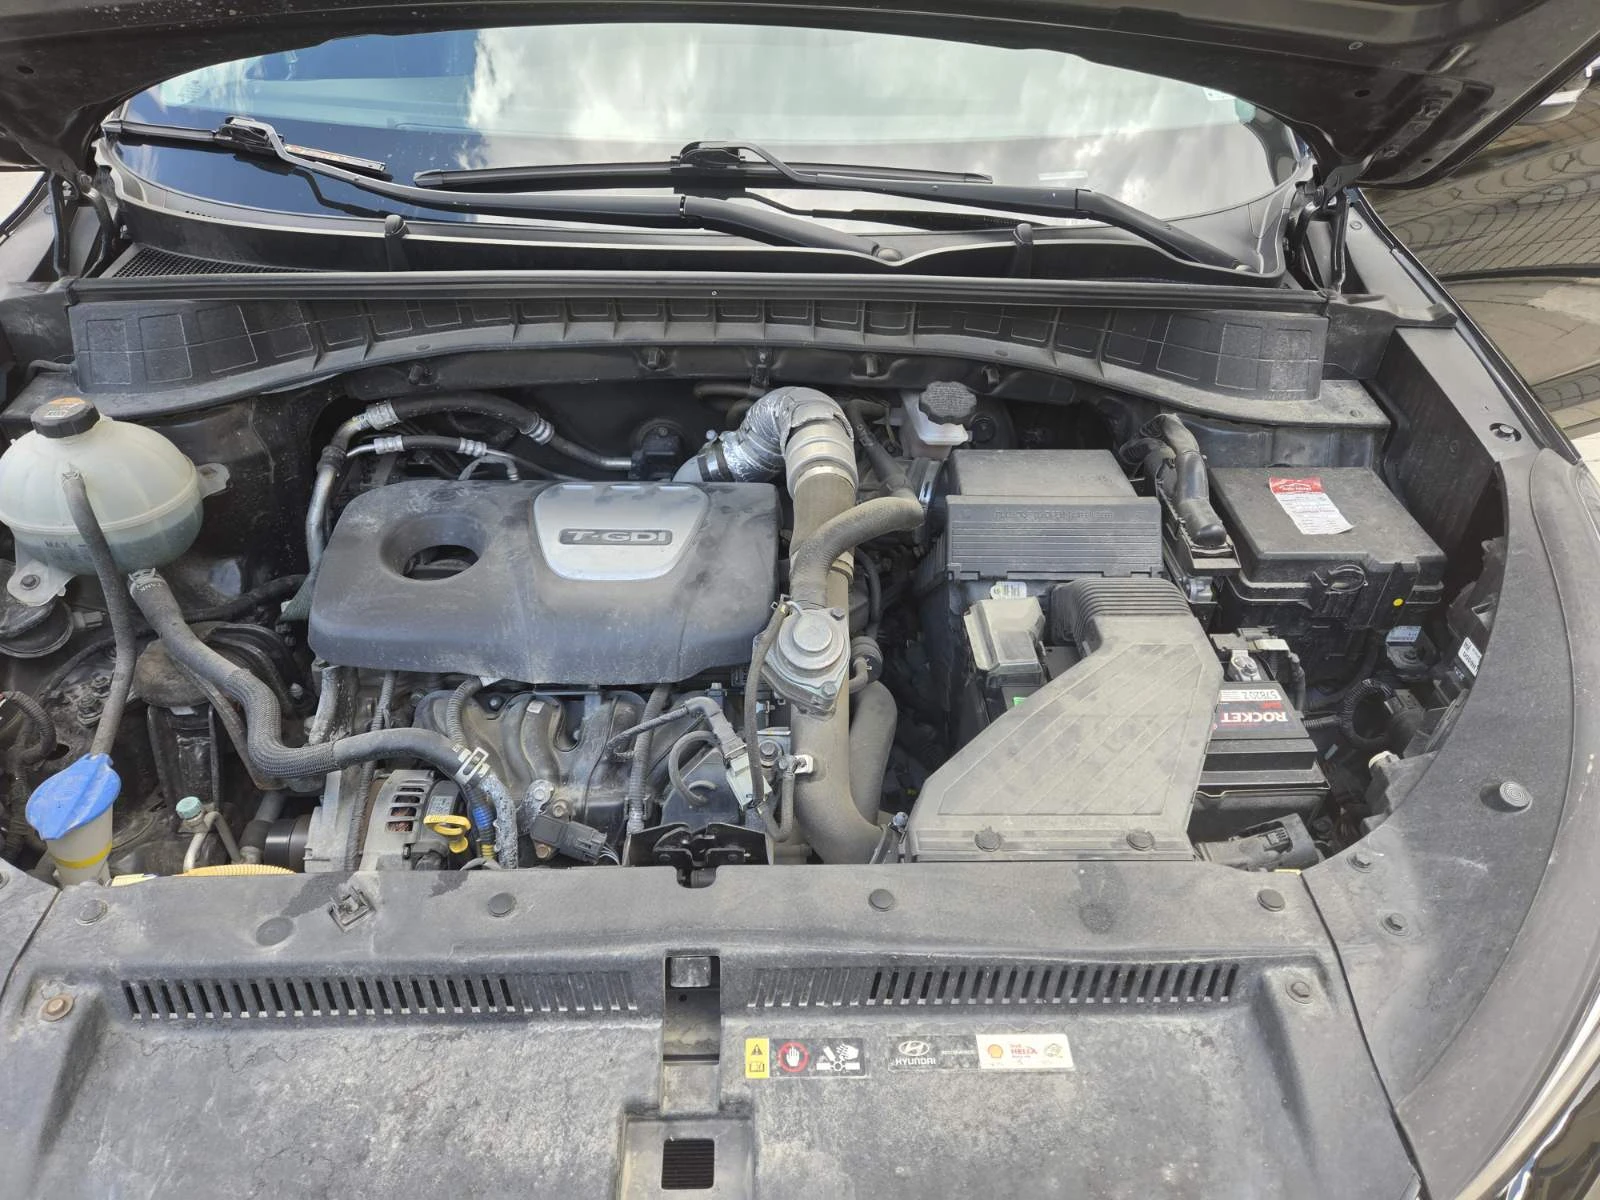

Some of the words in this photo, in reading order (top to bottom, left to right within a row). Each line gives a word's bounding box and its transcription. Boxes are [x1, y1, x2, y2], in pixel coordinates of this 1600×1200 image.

[567, 530, 666, 542] T-GDI
[1220, 711, 1289, 723] ROCKET
[895, 1057, 937, 1066] HYUNDAI
